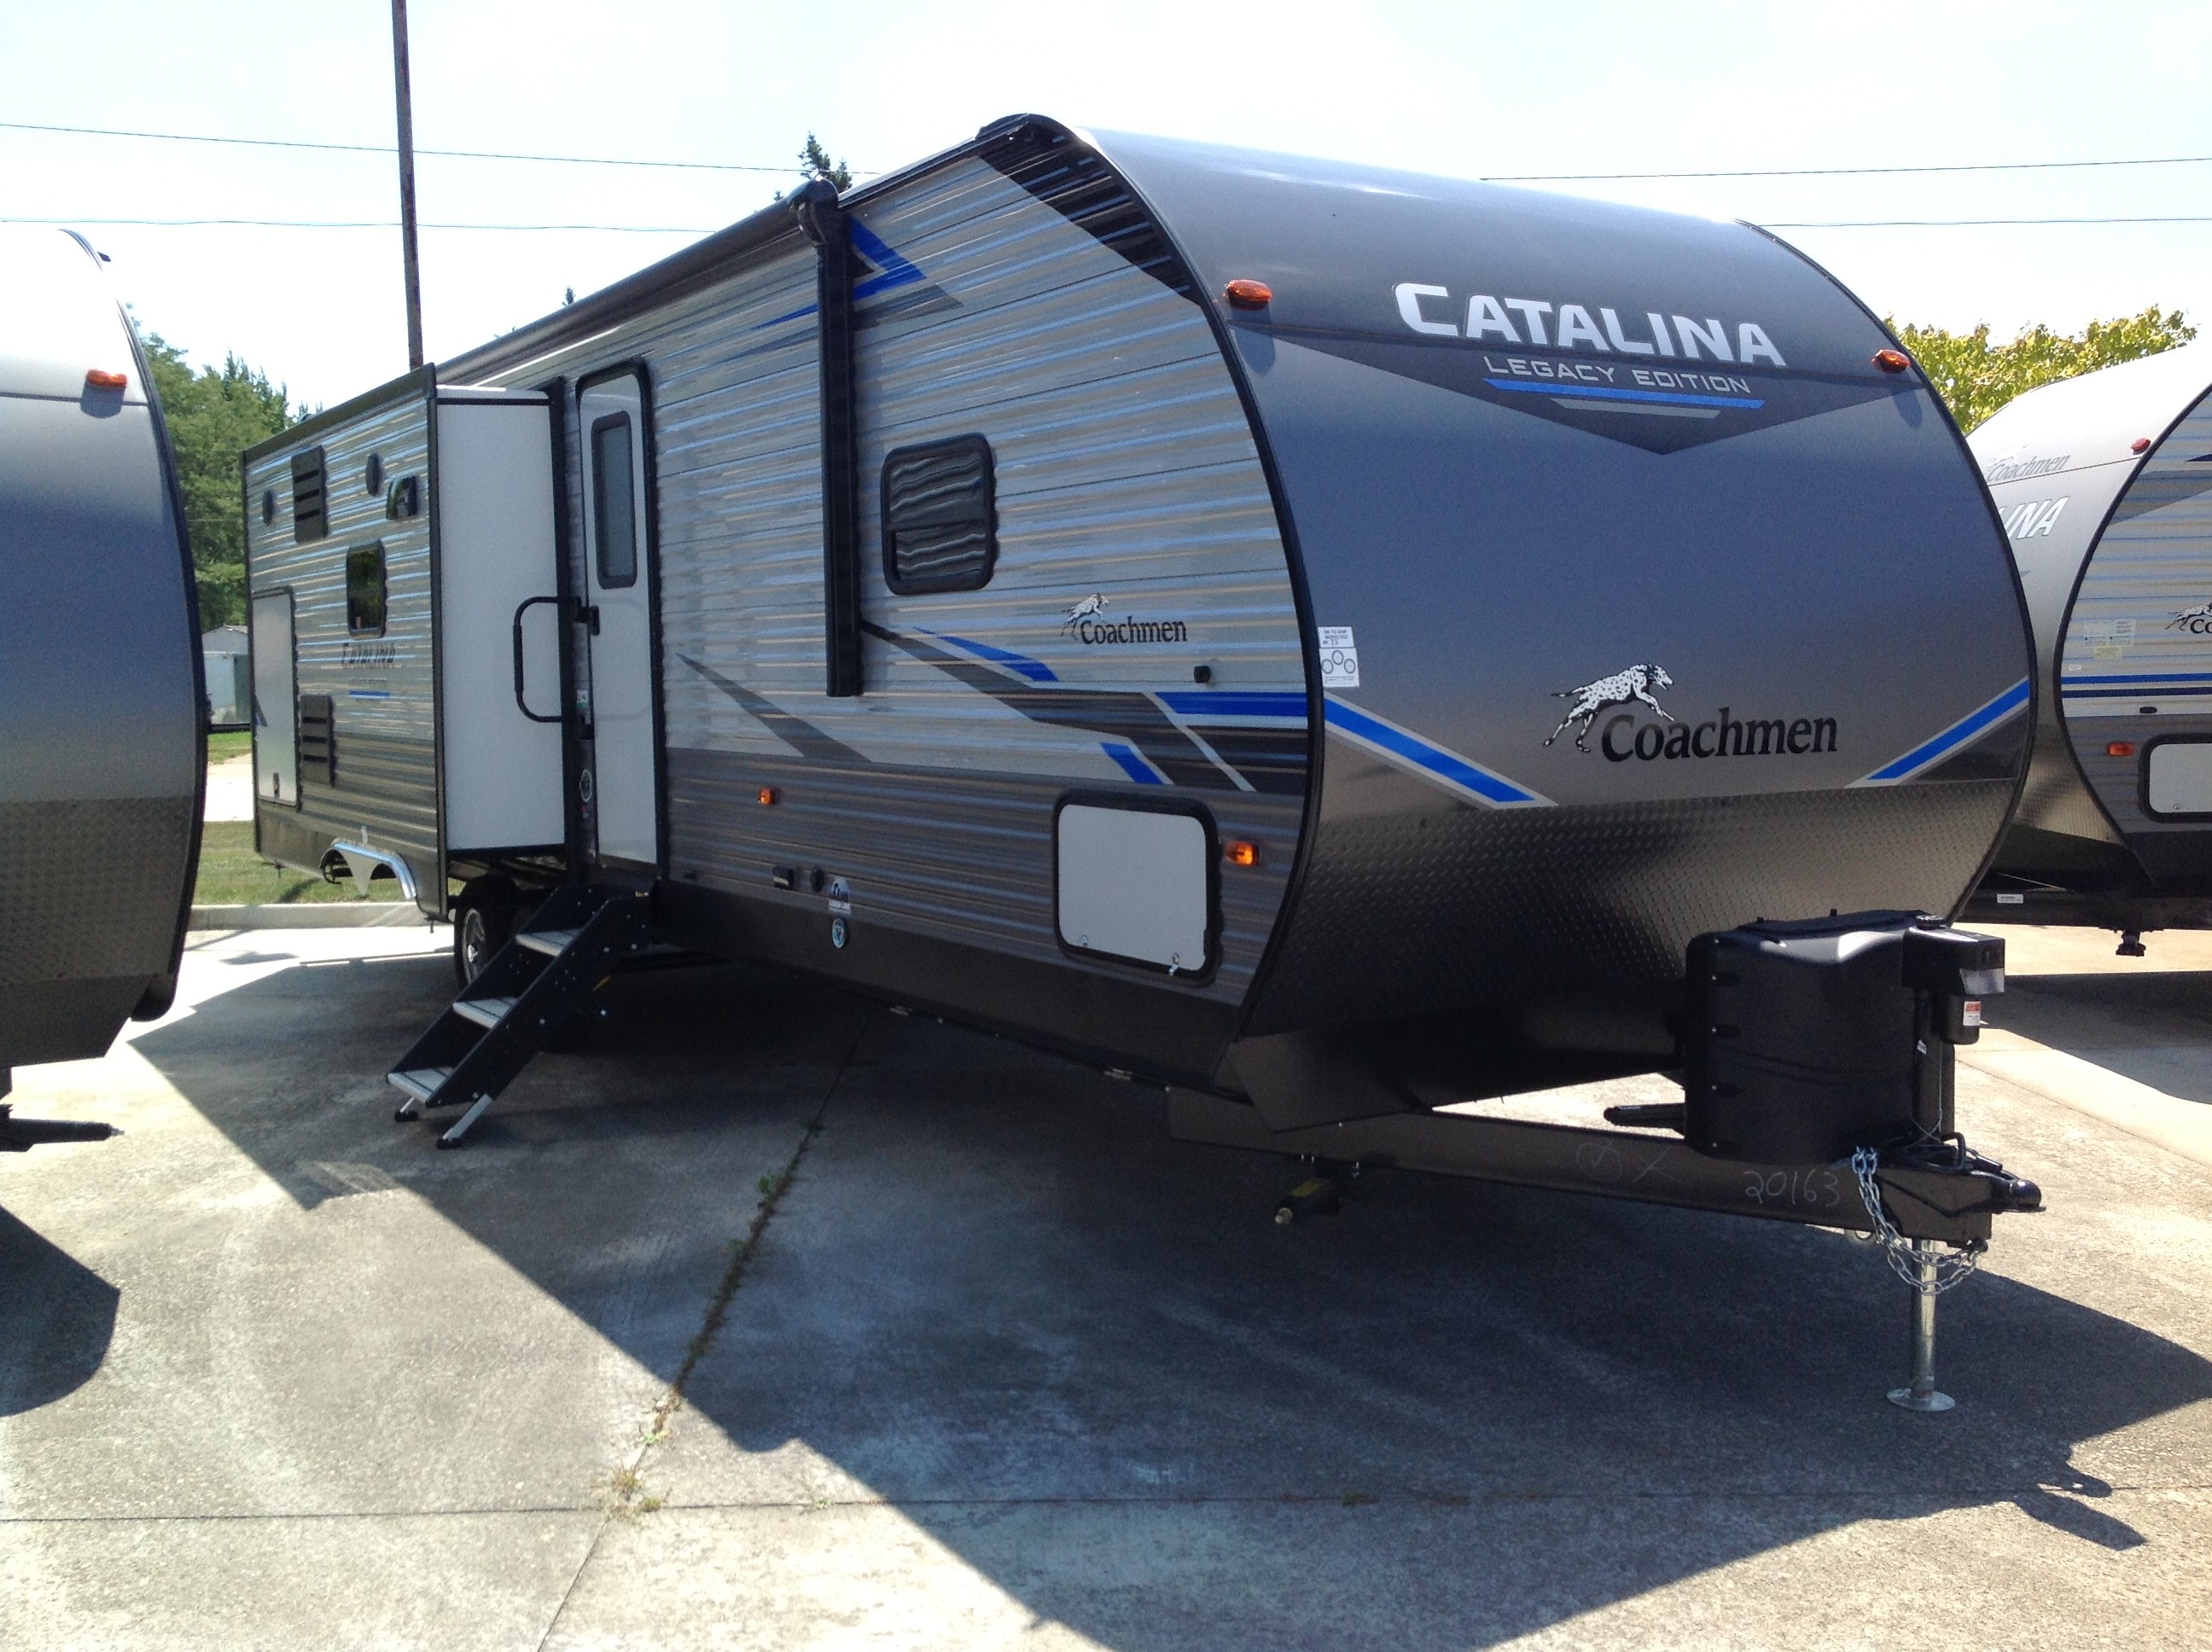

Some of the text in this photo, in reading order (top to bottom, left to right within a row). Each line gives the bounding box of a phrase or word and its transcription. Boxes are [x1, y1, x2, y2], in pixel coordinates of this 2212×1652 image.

[1394, 282, 1787, 367] CATALINA
[1482, 355, 1752, 394] LEGACY EDITION
[1998, 495, 2071, 539] INA
[1080, 614, 1189, 645] Coachmen
[1600, 707, 1838, 763] Coachmen
[1743, 1168, 1840, 1207] 20163
